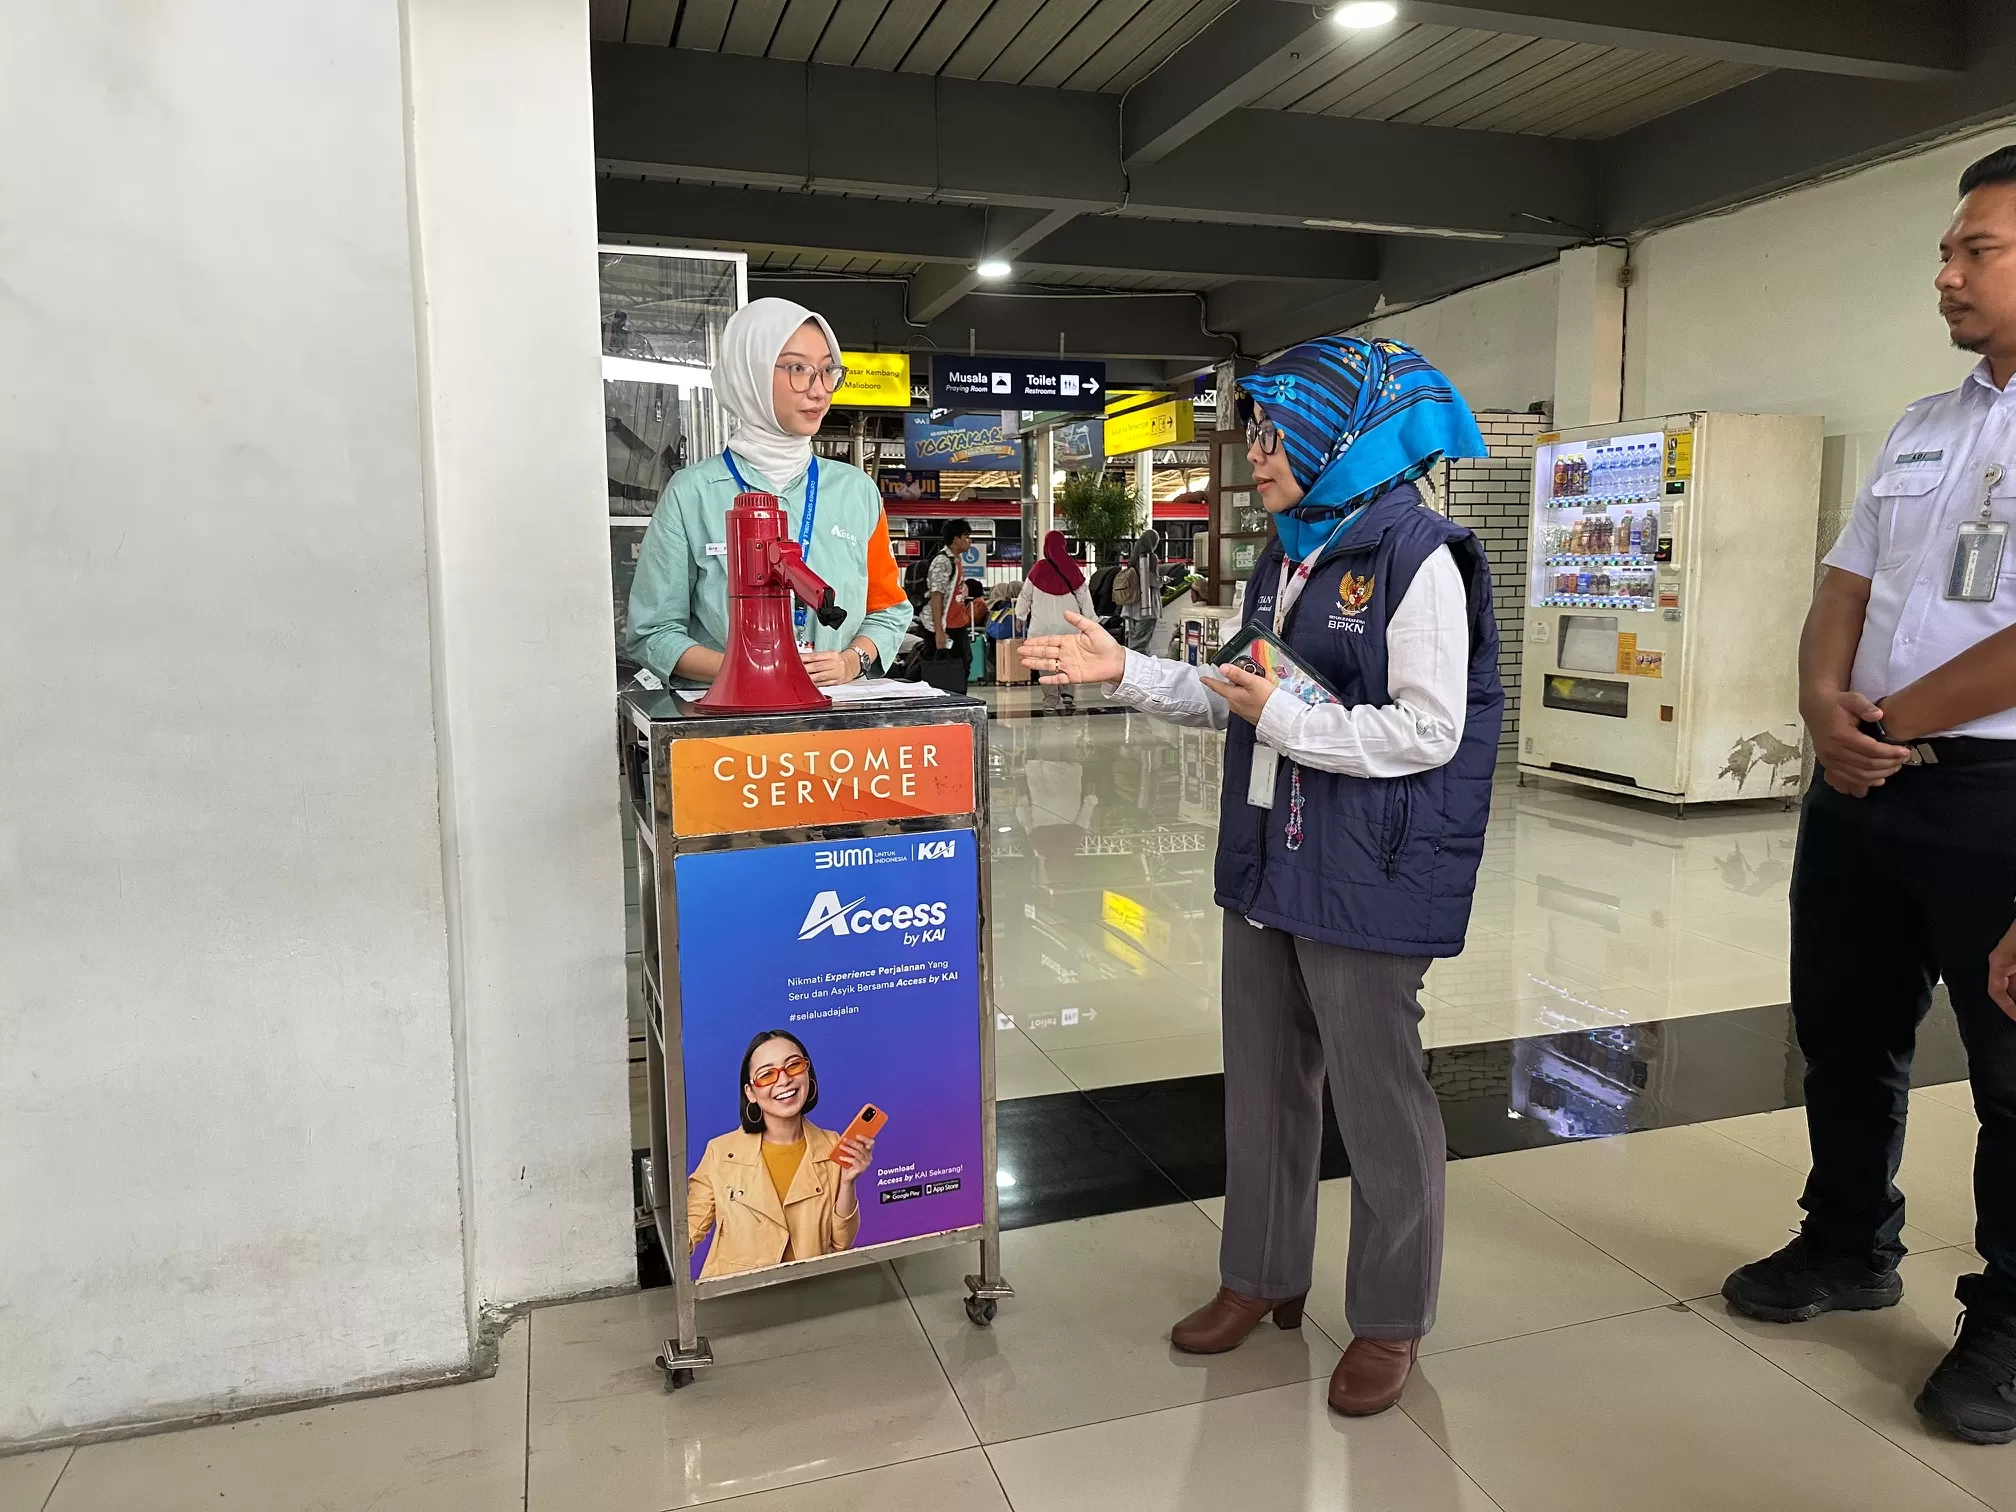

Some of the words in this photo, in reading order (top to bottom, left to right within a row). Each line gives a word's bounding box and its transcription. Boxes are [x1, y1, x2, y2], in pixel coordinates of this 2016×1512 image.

[866, 368, 900, 379] Kembang
[949, 371, 988, 384] Musala
[1026, 374, 1056, 386] Toilet
[844, 382, 882, 390] Malioboro
[946, 384, 969, 393] Praying
[970, 385, 988, 393] Room
[1024, 387, 1056, 396] Restrooms
[916, 426, 1002, 458] YOGYAKAR
[1327, 620, 1365, 635] BPKN
[713, 744, 939, 782] CUSTOMER
[742, 773, 917, 809] SERVICE
[918, 840, 956, 860] KAI
[815, 847, 873, 870] BUMN
[875, 850, 896, 858] UNTUK
[875, 856, 908, 864] INDONESIA
[797, 890, 948, 941] Access
[903, 932, 919, 947] by
[922, 928, 945, 943] KAI
[787, 974, 823, 987] Nikmati
[825, 969, 876, 984] Experience
[878, 962, 926, 976] Perjalanan
[927, 960, 949, 970] Yang
[788, 992, 810, 1002] Seru
[812, 989, 829, 999] dan
[830, 985, 855, 997] Asyik
[857, 980, 895, 993] Bersama
[896, 976, 927, 988] Access
[928, 974, 940, 985] by
[941, 971, 958, 982] KAI
[789, 1005, 860, 1022] #selaluadajalan
[877, 1163, 915, 1176] Download
[877, 1176, 903, 1187] Access
[904, 1174, 914, 1183] by
[914, 1171, 928, 1180] KAI
[929, 1164, 963, 1178] Sekarang!
[892, 1192, 909, 1200] Google
[909, 1190, 920, 1198] Play
[945, 1183, 959, 1191] Store
